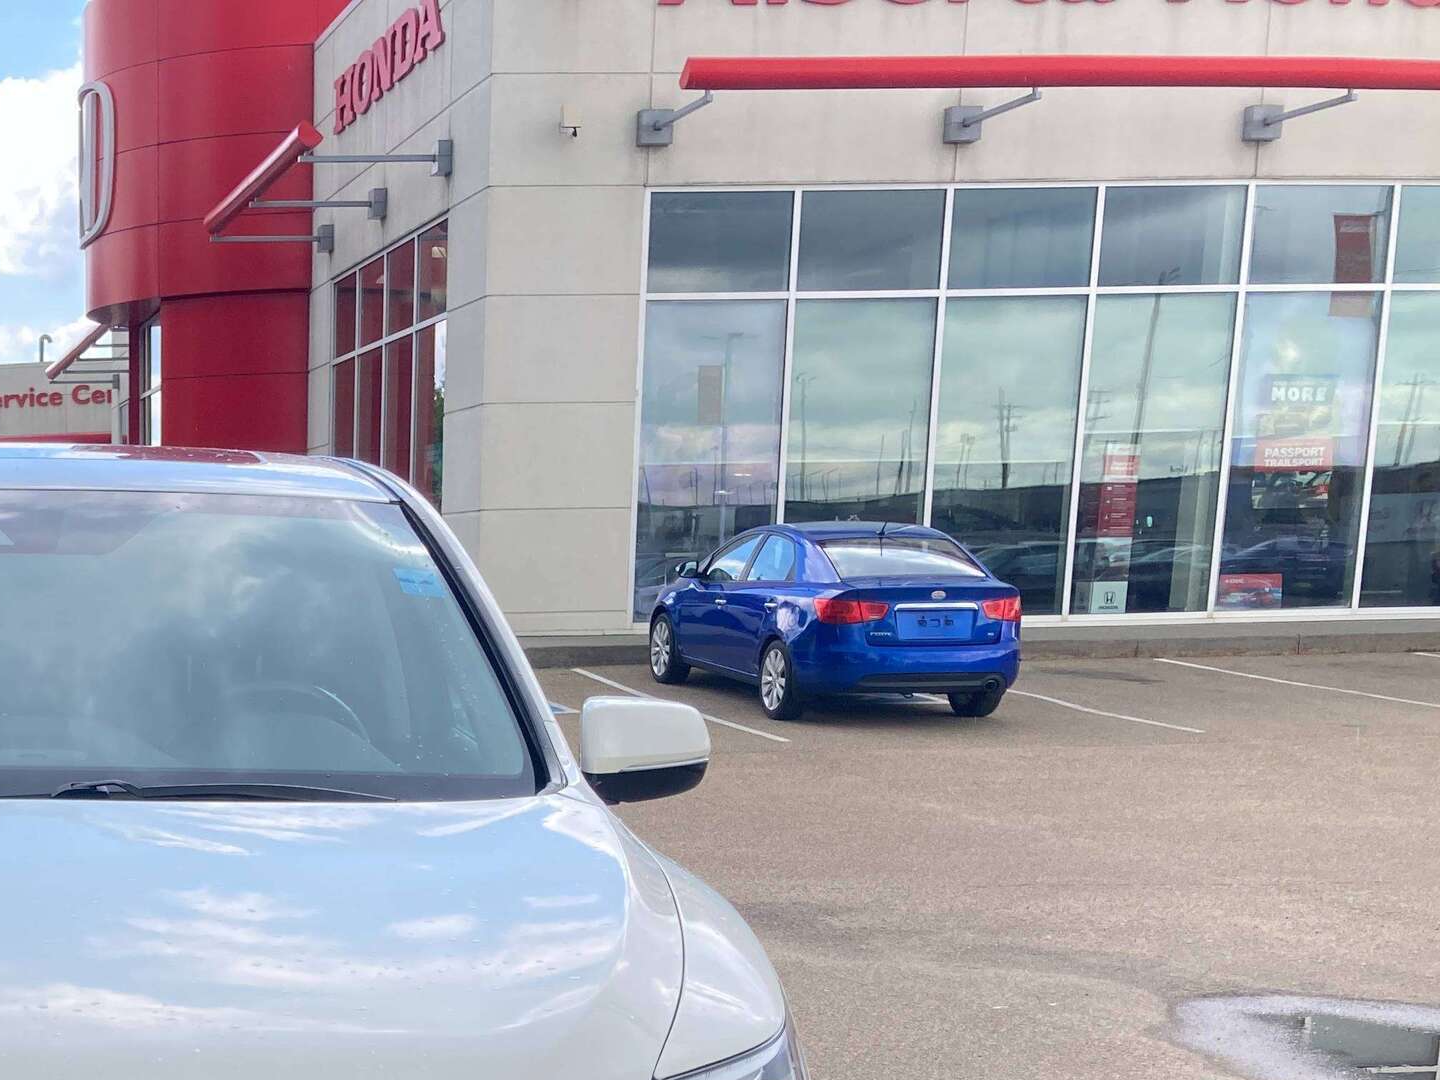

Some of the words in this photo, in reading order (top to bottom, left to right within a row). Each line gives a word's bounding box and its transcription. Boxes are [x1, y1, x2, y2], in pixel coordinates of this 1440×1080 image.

[334, 0, 446, 135] HONDA
[1271, 386, 1328, 401] MORE
[1263, 446, 1326, 458] PASSPORT
[1263, 457, 1324, 467] TRAILSPORT
